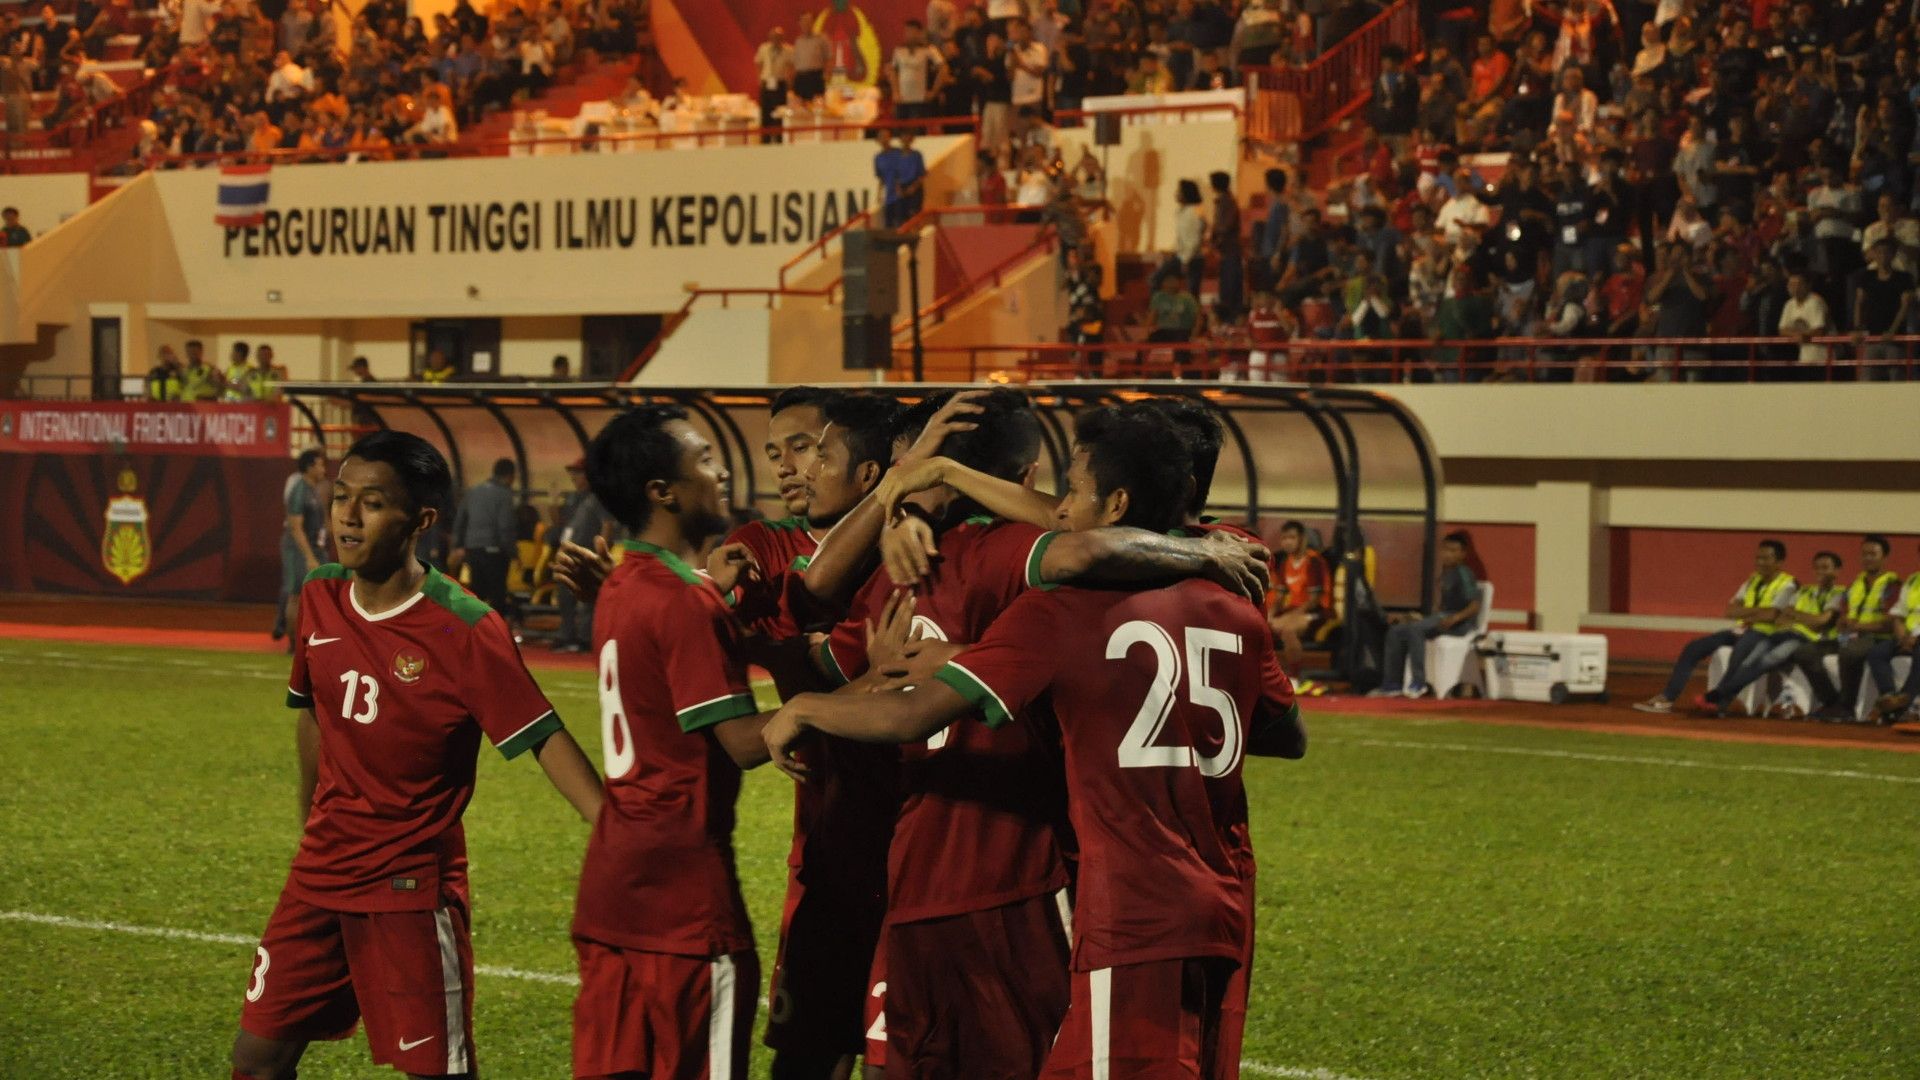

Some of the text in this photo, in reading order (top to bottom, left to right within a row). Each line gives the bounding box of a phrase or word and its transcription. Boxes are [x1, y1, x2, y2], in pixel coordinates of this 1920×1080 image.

[223, 205, 416, 257] PERGURUAN
[428, 201, 541, 253] TINGGI
[554, 196, 637, 250] ILMU
[19, 411, 256, 445] INTERNATIONAL FRIENDLY MATCH
[340, 669, 379, 725] 13
[599, 639, 635, 779] 8
[1105, 620, 1242, 778] 25
